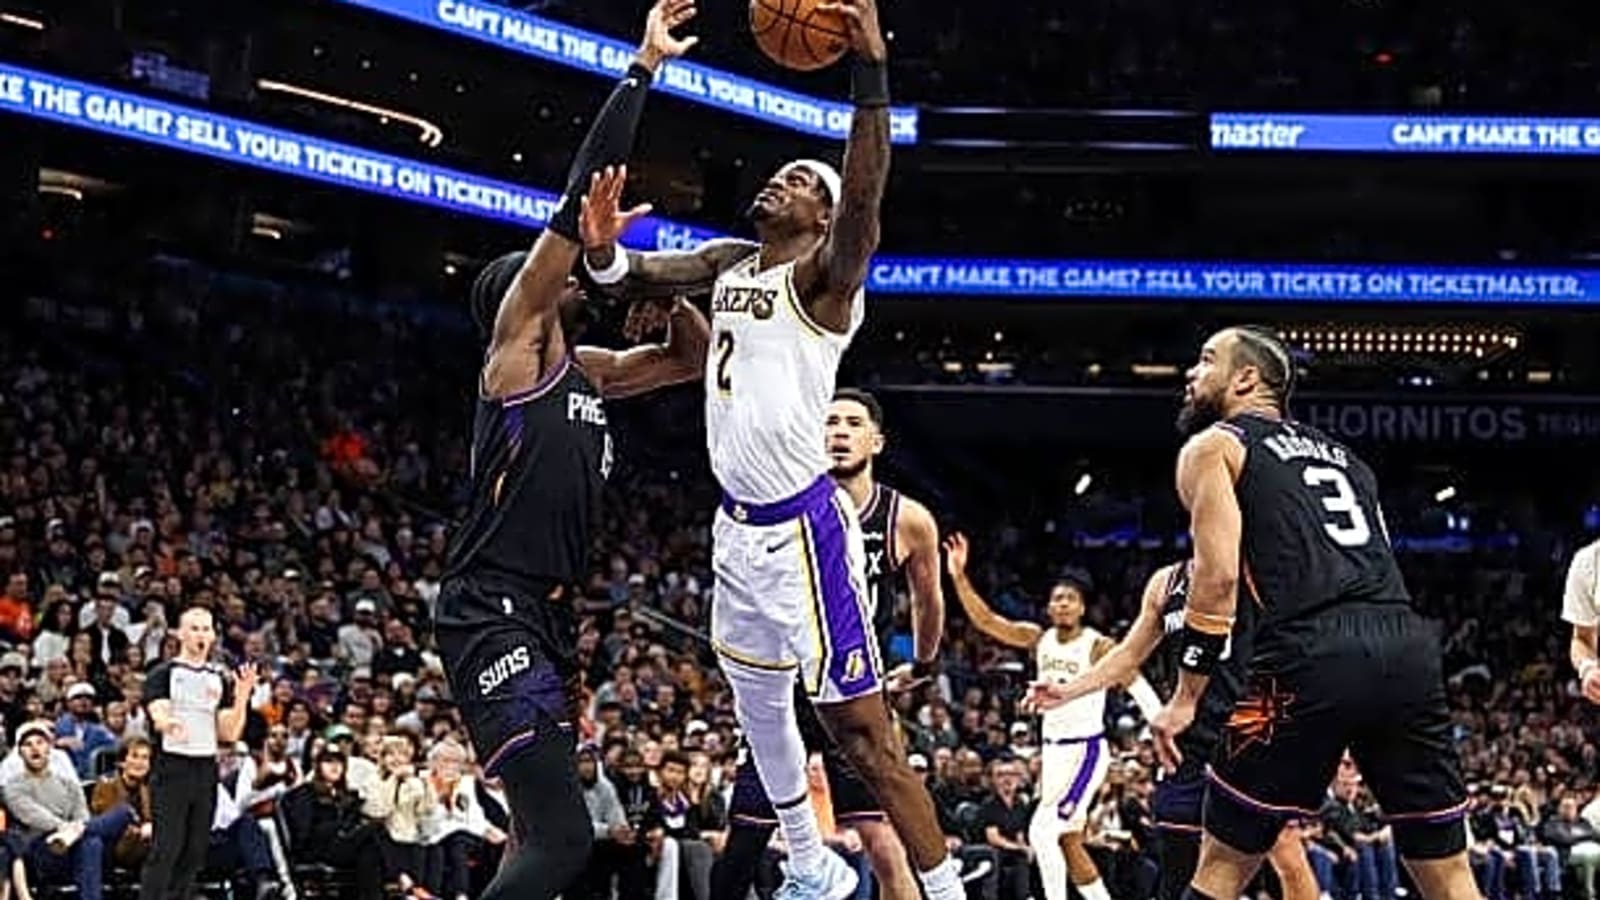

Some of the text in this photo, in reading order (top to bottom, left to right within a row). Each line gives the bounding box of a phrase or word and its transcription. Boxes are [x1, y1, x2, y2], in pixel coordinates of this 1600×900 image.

[503, 17, 559, 51] MAKE
[561, 34, 599, 64] THE
[665, 63, 707, 95] SELL
[708, 77, 755, 108] YOUR
[757, 91, 825, 134] TICKETS
[29, 81, 82, 117] THE
[85, 94, 172, 136] GAME?
[176, 115, 232, 151] SELL
[235, 129, 300, 166] YOUR
[304, 145, 393, 187] TICKETS
[397, 168, 430, 196] ON
[434, 175, 556, 223] TICKETMAST
[1393, 122, 1600, 146] CAN'T MAKE THE G
[872, 264, 1585, 296] CAN'T MAKE THE GAME? SELL YOUR TICKETS ON TICKETMASTER.
[717, 330, 735, 393] 2
[1308, 405, 1527, 440] HORNITOS
[1303, 465, 1371, 547] 3
